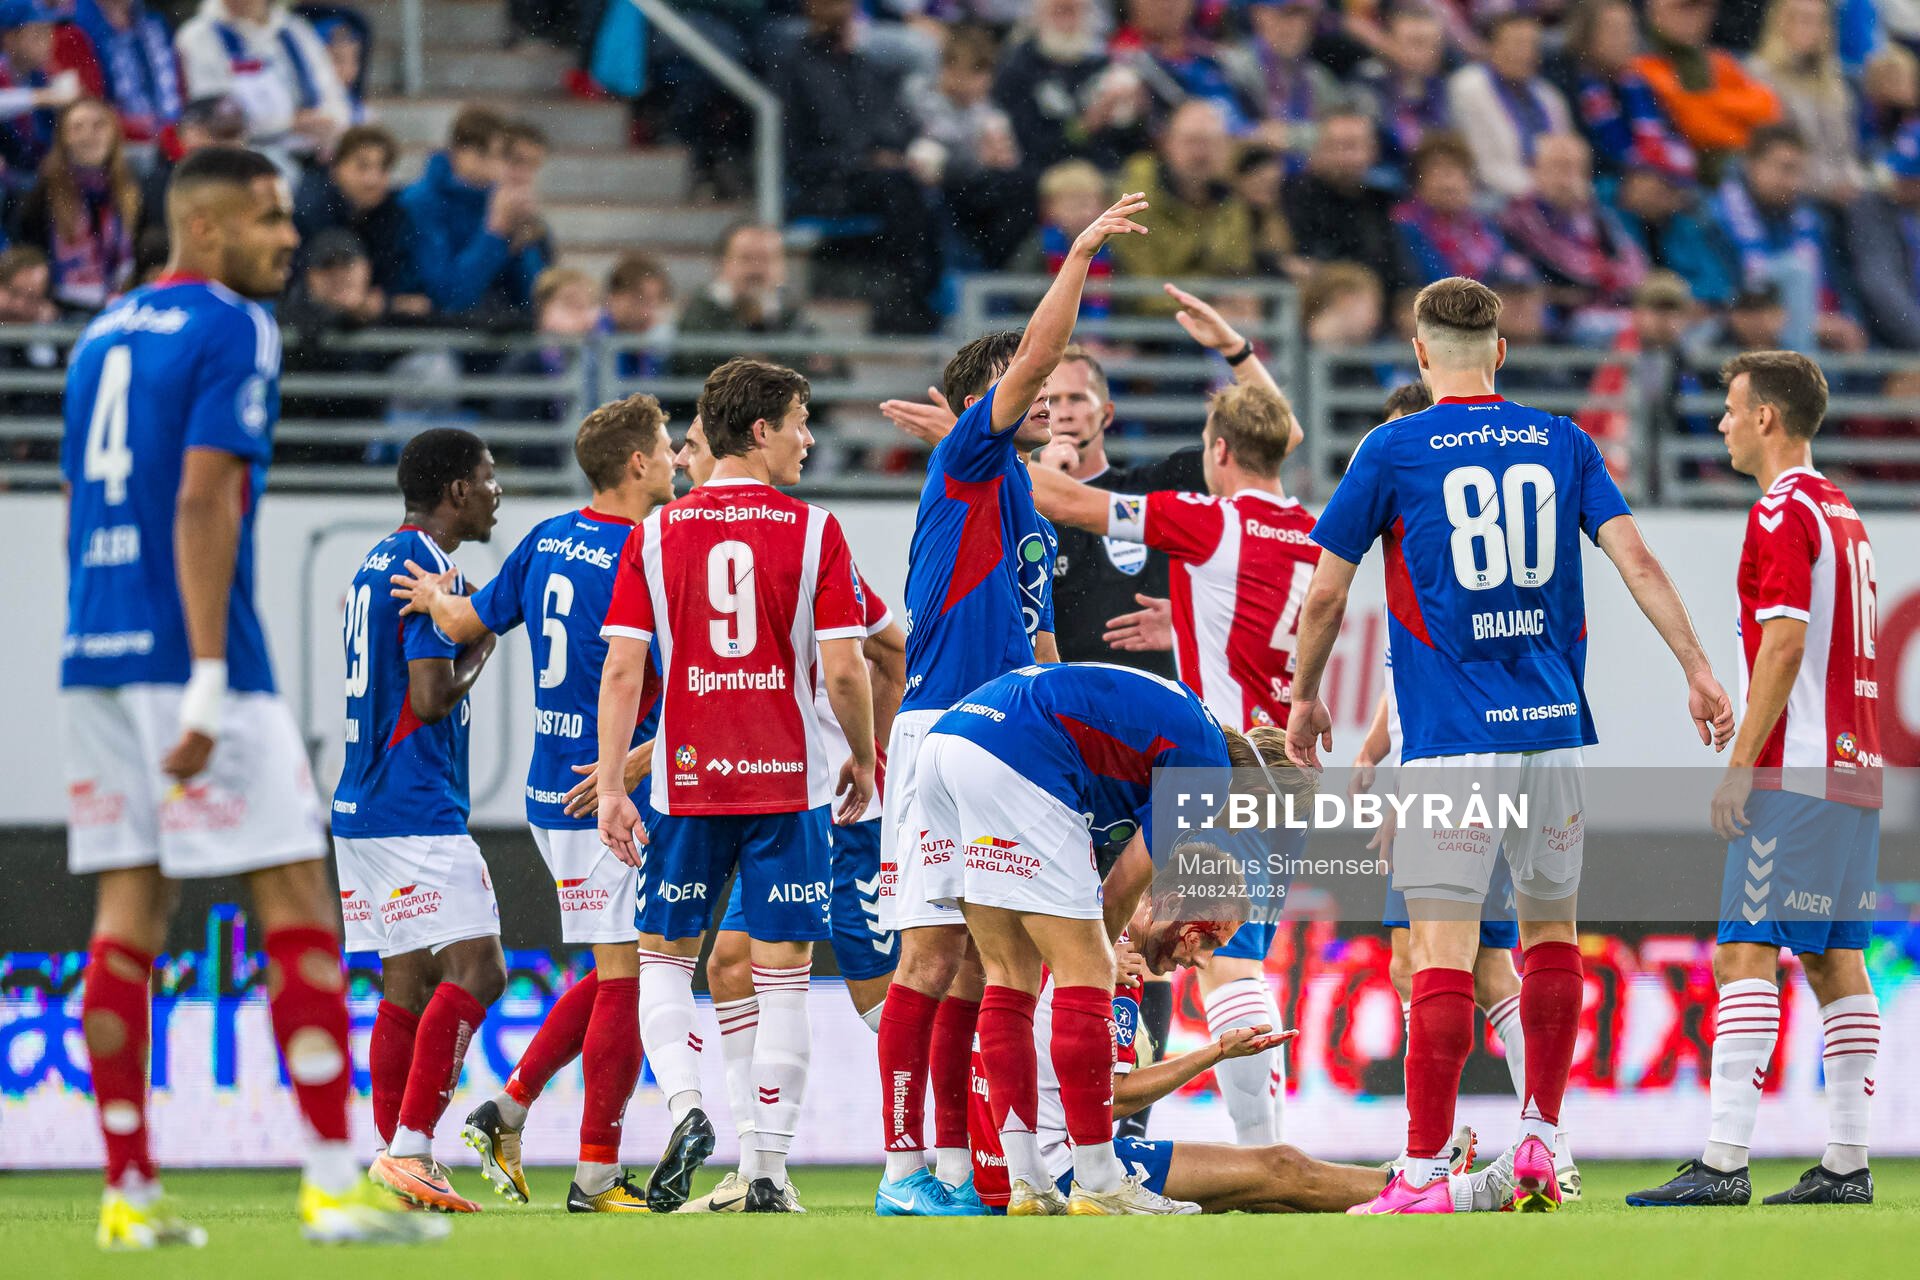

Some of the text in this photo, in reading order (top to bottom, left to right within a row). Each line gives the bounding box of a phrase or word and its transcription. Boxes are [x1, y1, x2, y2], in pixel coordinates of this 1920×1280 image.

[84, 345, 134, 507] 4
[1430, 424, 1549, 450] comfyballs
[668, 504, 797, 524] RørosBanken
[1443, 463, 1556, 591] 80
[537, 536, 614, 570] comfyballs
[707, 540, 758, 658] 9
[1846, 537, 1877, 660] 16
[538, 573, 575, 689] 6
[1471, 608, 1544, 640] BRAJAAC
[687, 665, 786, 696] Bjørntvedt
[1485, 702, 1577, 723] mot rasisme
[736, 758, 804, 775] Oslobuss
[657, 879, 829, 905] AIDER AIDER
[1783, 889, 1833, 916] AIDER
[384, 903, 438, 925] CARGLASS
